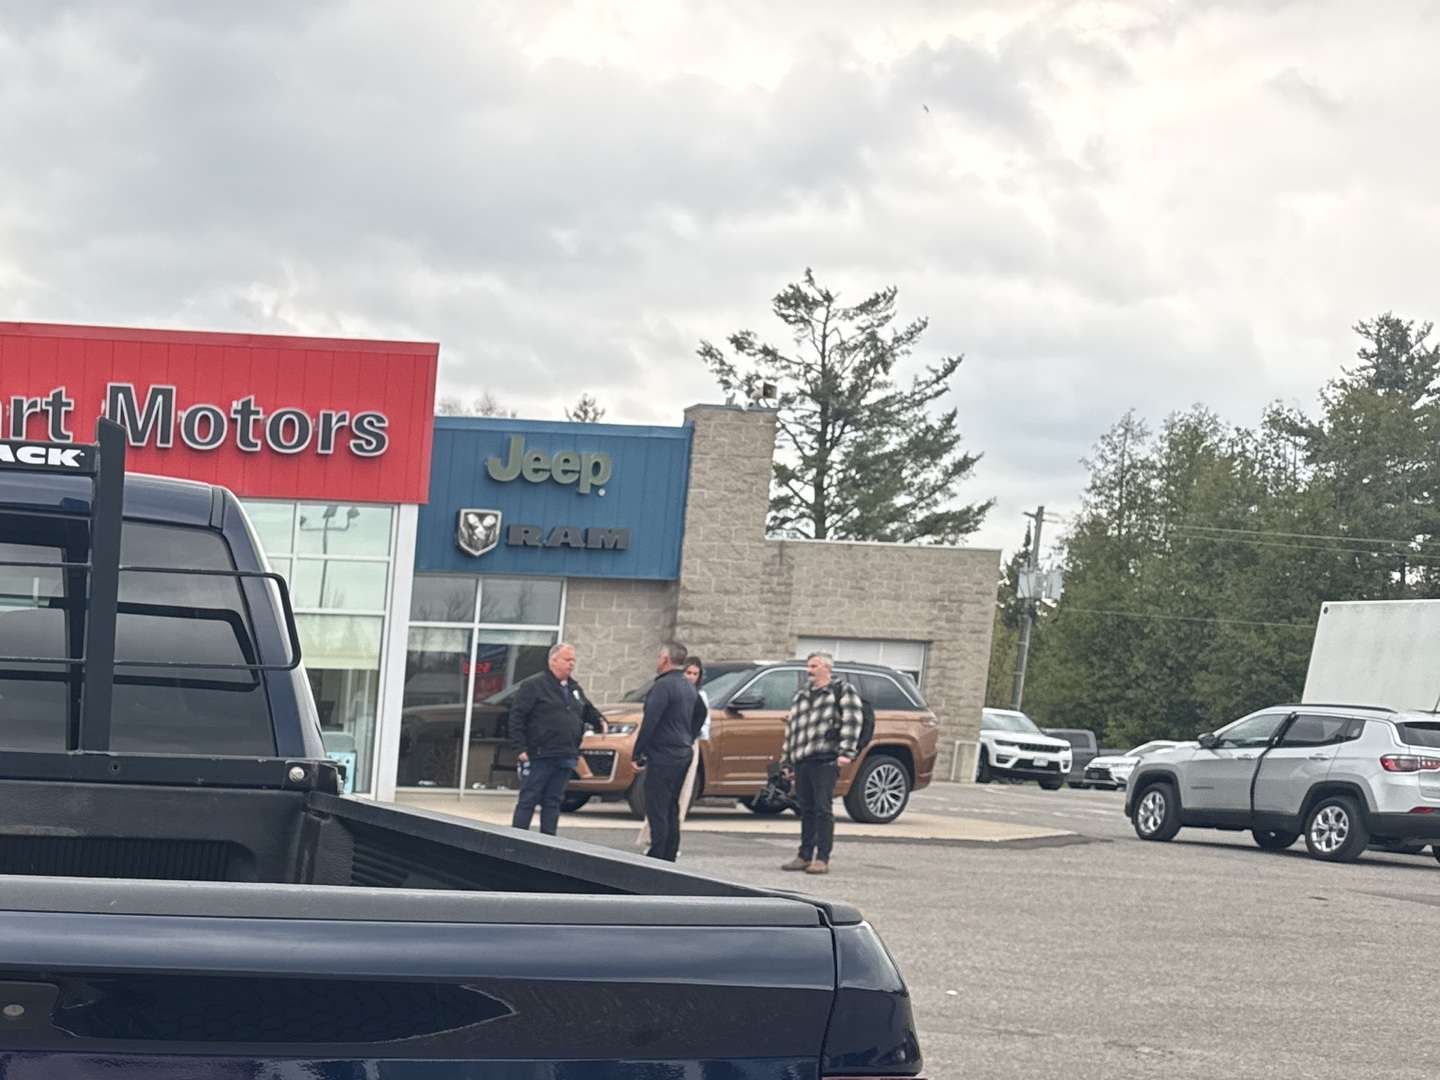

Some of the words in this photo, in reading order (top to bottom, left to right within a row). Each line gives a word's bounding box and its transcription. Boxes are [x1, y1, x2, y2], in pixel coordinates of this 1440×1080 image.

[105, 382, 389, 456] Motors
[486, 434, 612, 494] Jeep
[507, 525, 632, 550] RAM
